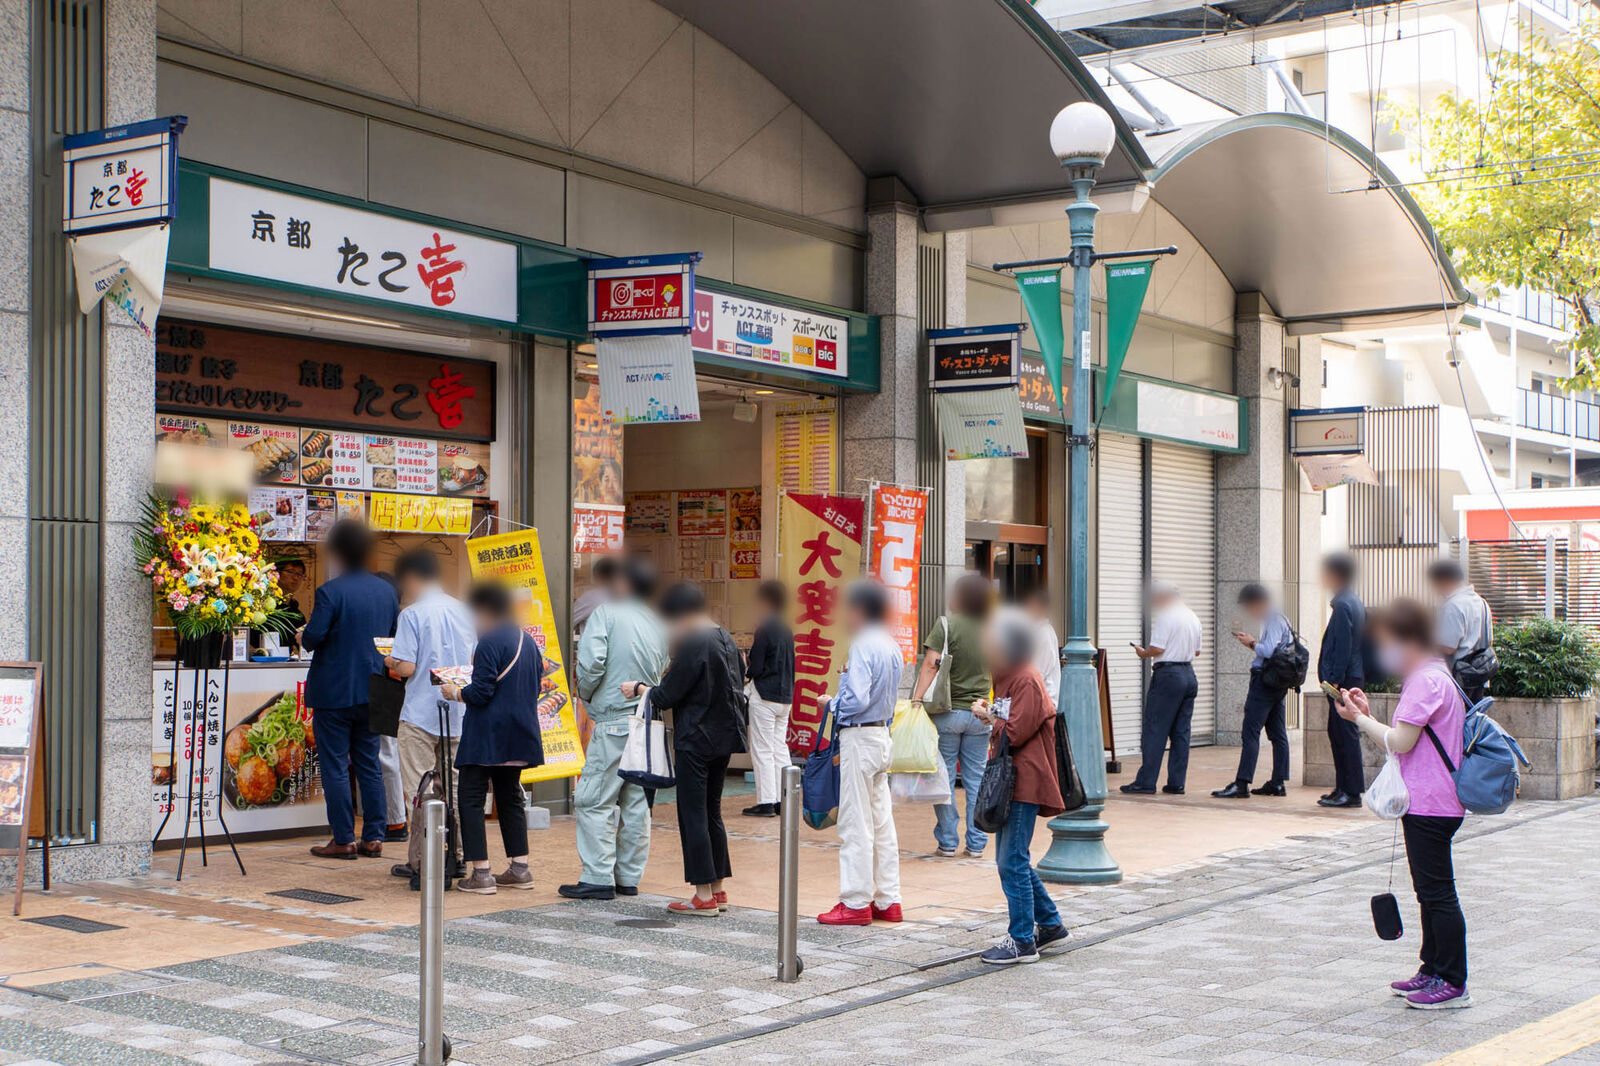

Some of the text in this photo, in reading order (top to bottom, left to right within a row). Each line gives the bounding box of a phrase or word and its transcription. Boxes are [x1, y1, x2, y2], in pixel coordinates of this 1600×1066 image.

[103, 160, 128, 177] 京都
[251, 210, 311, 249] 京都
[633, 288, 654, 297] 宝くじ
[601, 306, 680, 321] チャンススポットACT高槻
[693, 310, 710, 333] じ
[721, 301, 788, 326] チャンススポット
[736, 320, 773, 341] ACT 高槻
[299, 359, 344, 390] 京都
[626, 373, 639, 383] ACT
[1026, 401, 1034, 409] da
[1034, 402, 1050, 413] Gama
[373, 496, 468, 530] 店内入口
[607, 515, 624, 549] 5
[163, 679, 174, 740] たこ焼き
[183, 700, 193, 721] 10個
[207, 678, 220, 746] へんこ焼き
[184, 724, 192, 760] 650
